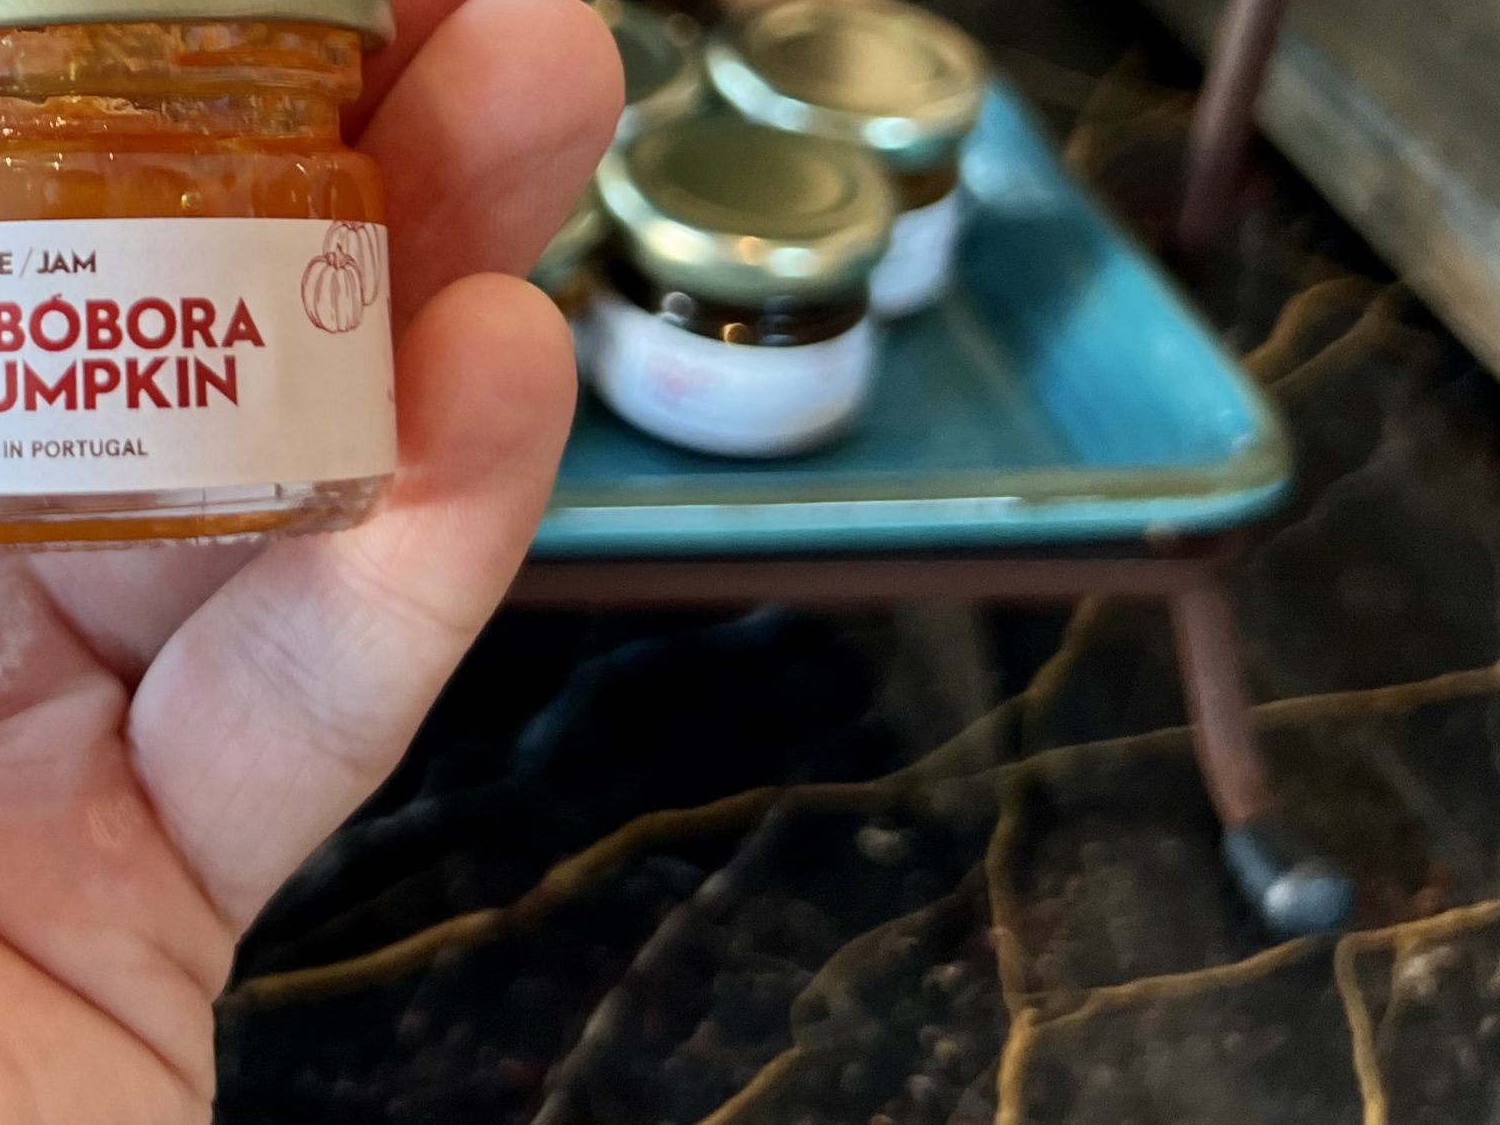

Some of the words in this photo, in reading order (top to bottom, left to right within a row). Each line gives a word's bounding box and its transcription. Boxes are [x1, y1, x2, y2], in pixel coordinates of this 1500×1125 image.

[37, 249, 97, 274] JAM
[3, 439, 24, 459] IN
[31, 437, 150, 458] PORTUGAL
